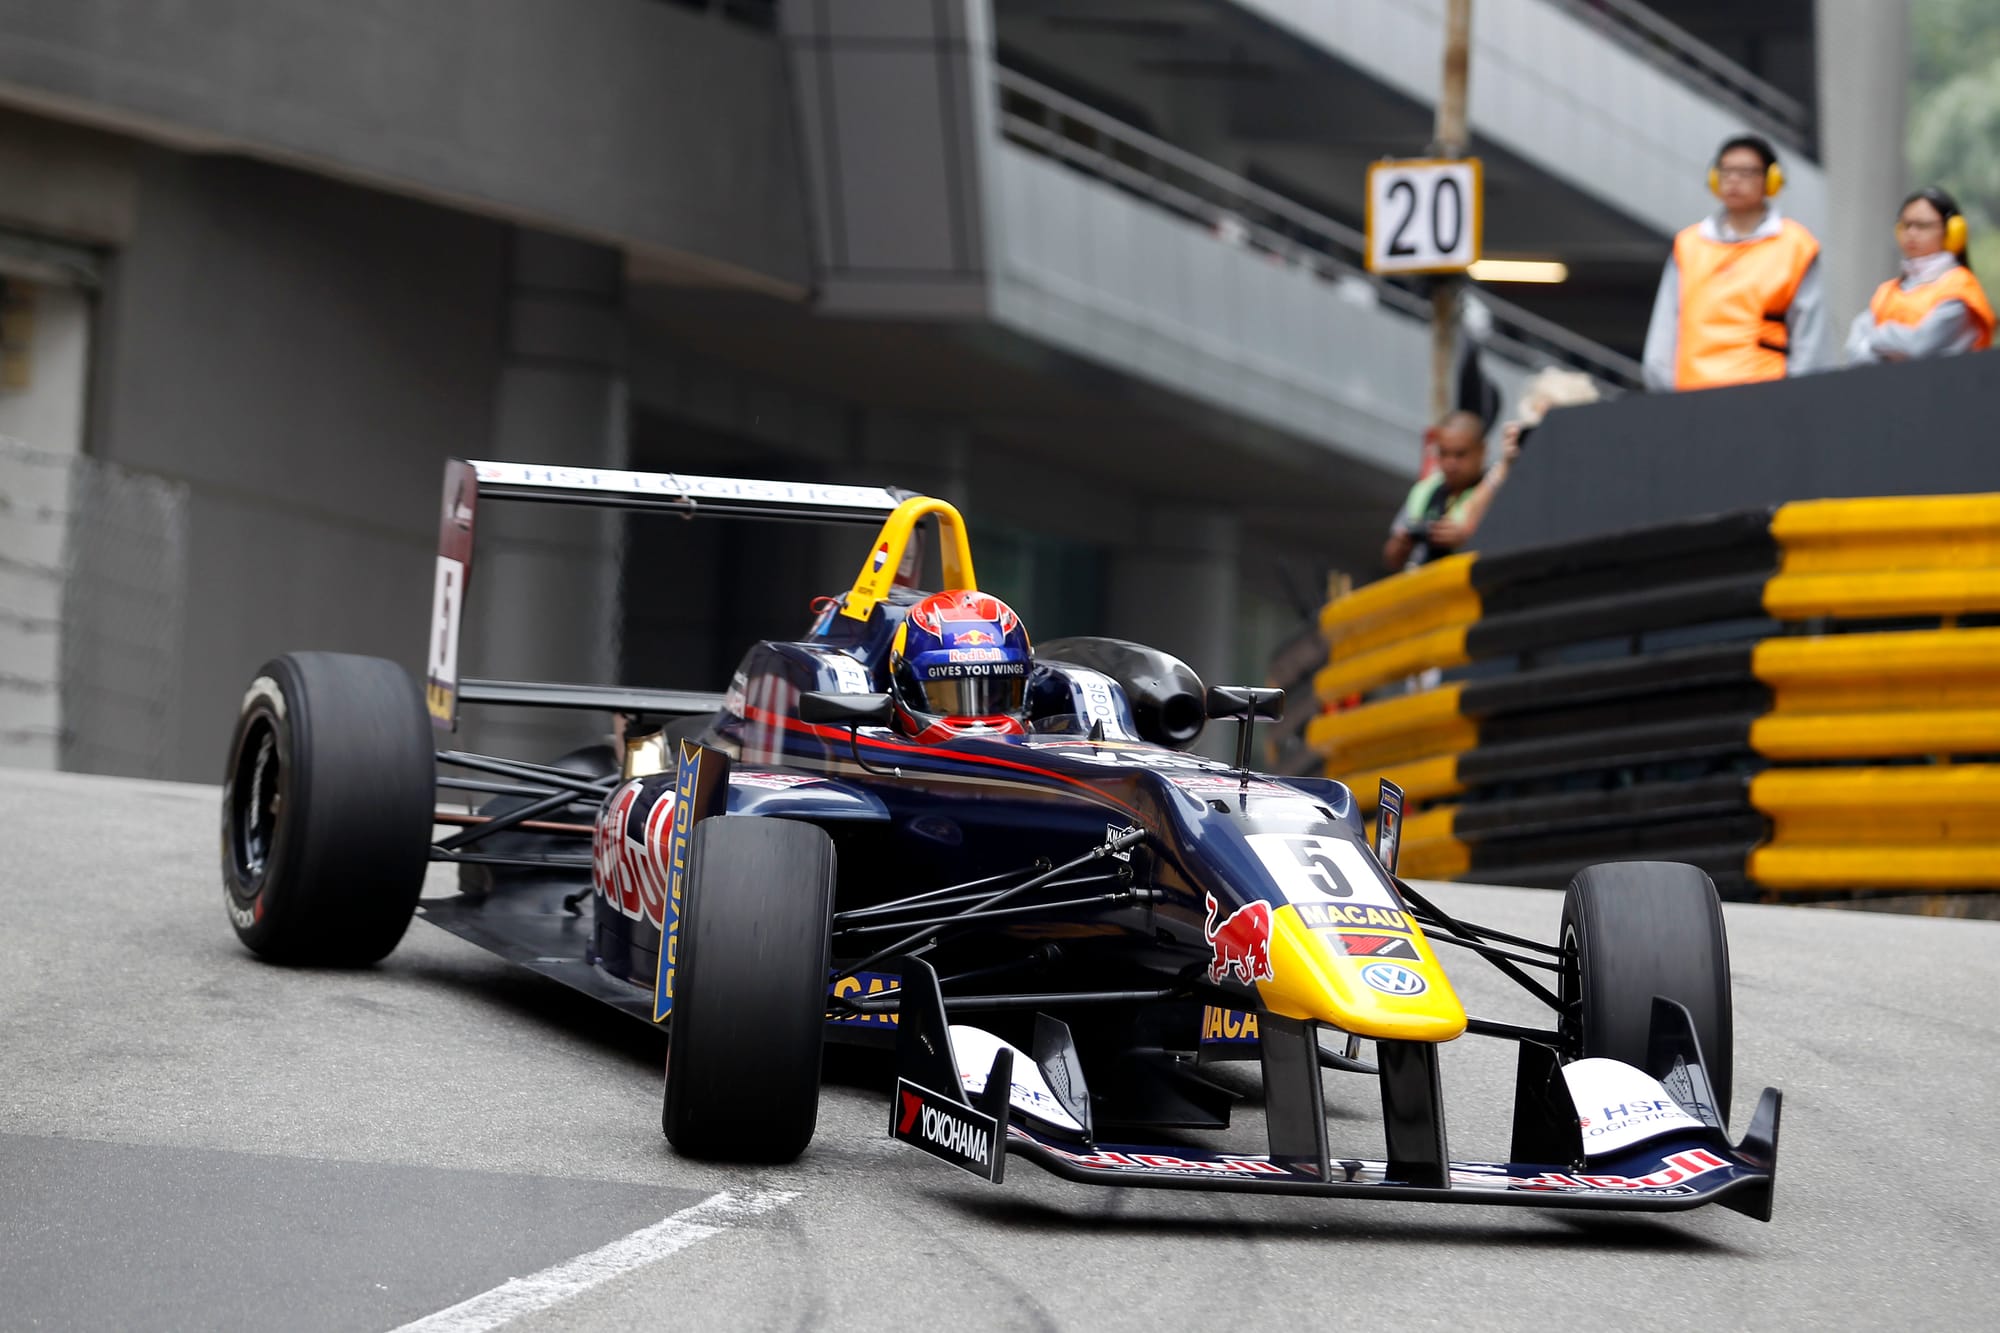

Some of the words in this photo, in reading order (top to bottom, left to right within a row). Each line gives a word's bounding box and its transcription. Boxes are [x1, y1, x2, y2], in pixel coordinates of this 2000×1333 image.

[1387, 178, 1462, 256] 20
[523, 470, 609, 485] HSF
[949, 649, 975, 662] Red
[975, 648, 1001, 661] Bull
[928, 666, 961, 677] GIVES
[964, 665, 990, 676] YOU
[993, 664, 1024, 675] WINGS
[1284, 839, 1354, 897] 5
[1298, 905, 1406, 928] MACAU
[1603, 1100, 1672, 1120] HSF
[921, 1103, 988, 1166] YOKOHAMA
[1570, 1148, 1734, 1190] Bull
